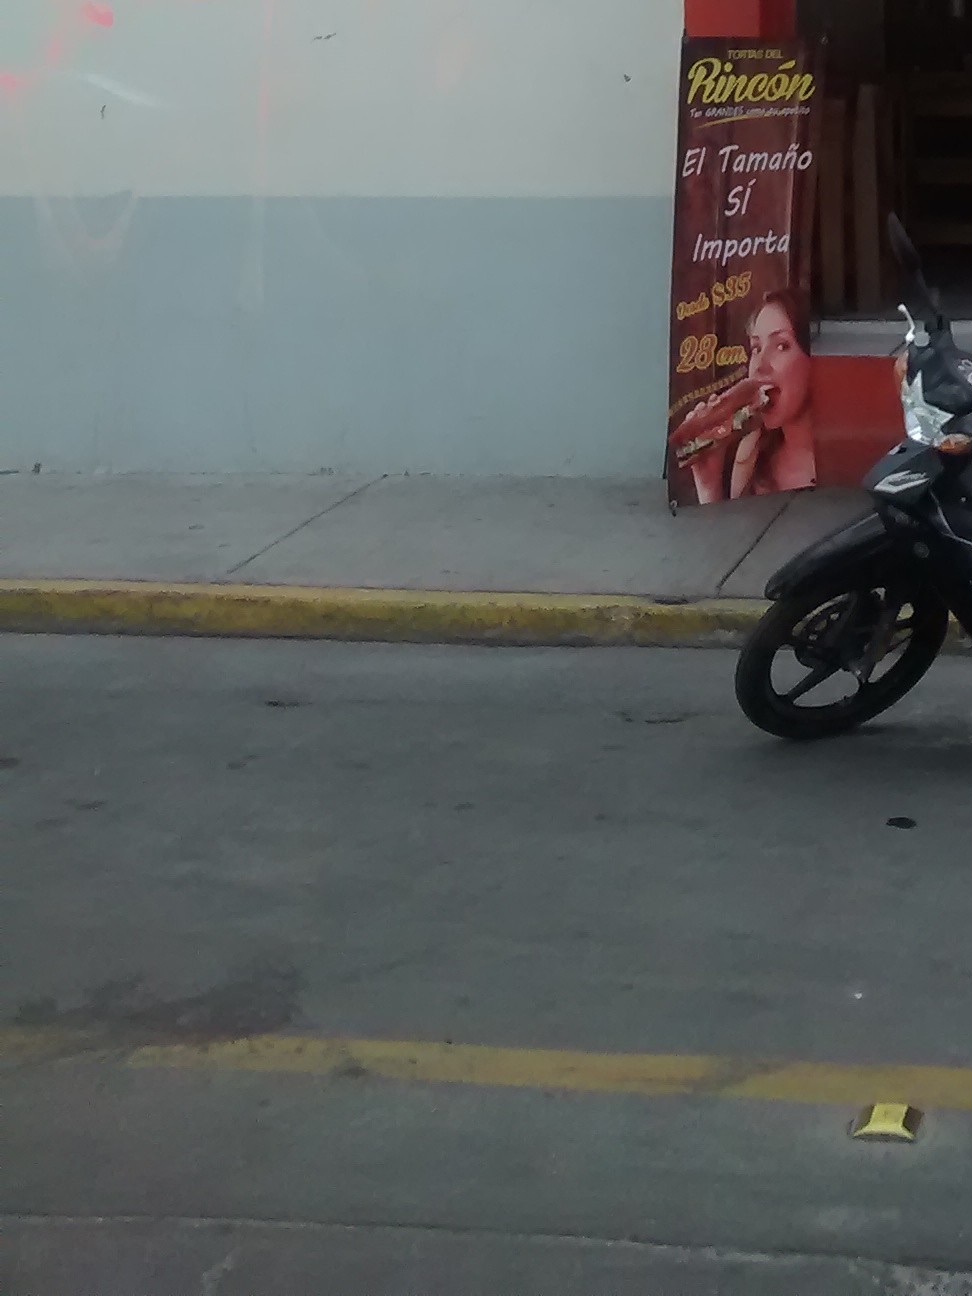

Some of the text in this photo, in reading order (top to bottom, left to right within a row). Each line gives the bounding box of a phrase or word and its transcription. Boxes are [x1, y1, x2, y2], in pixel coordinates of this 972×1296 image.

[687, 57, 816, 105] Rincón
[682, 143, 814, 178] El Tamaño
[692, 230, 791, 268] Importa
[676, 333, 718, 374] 28
